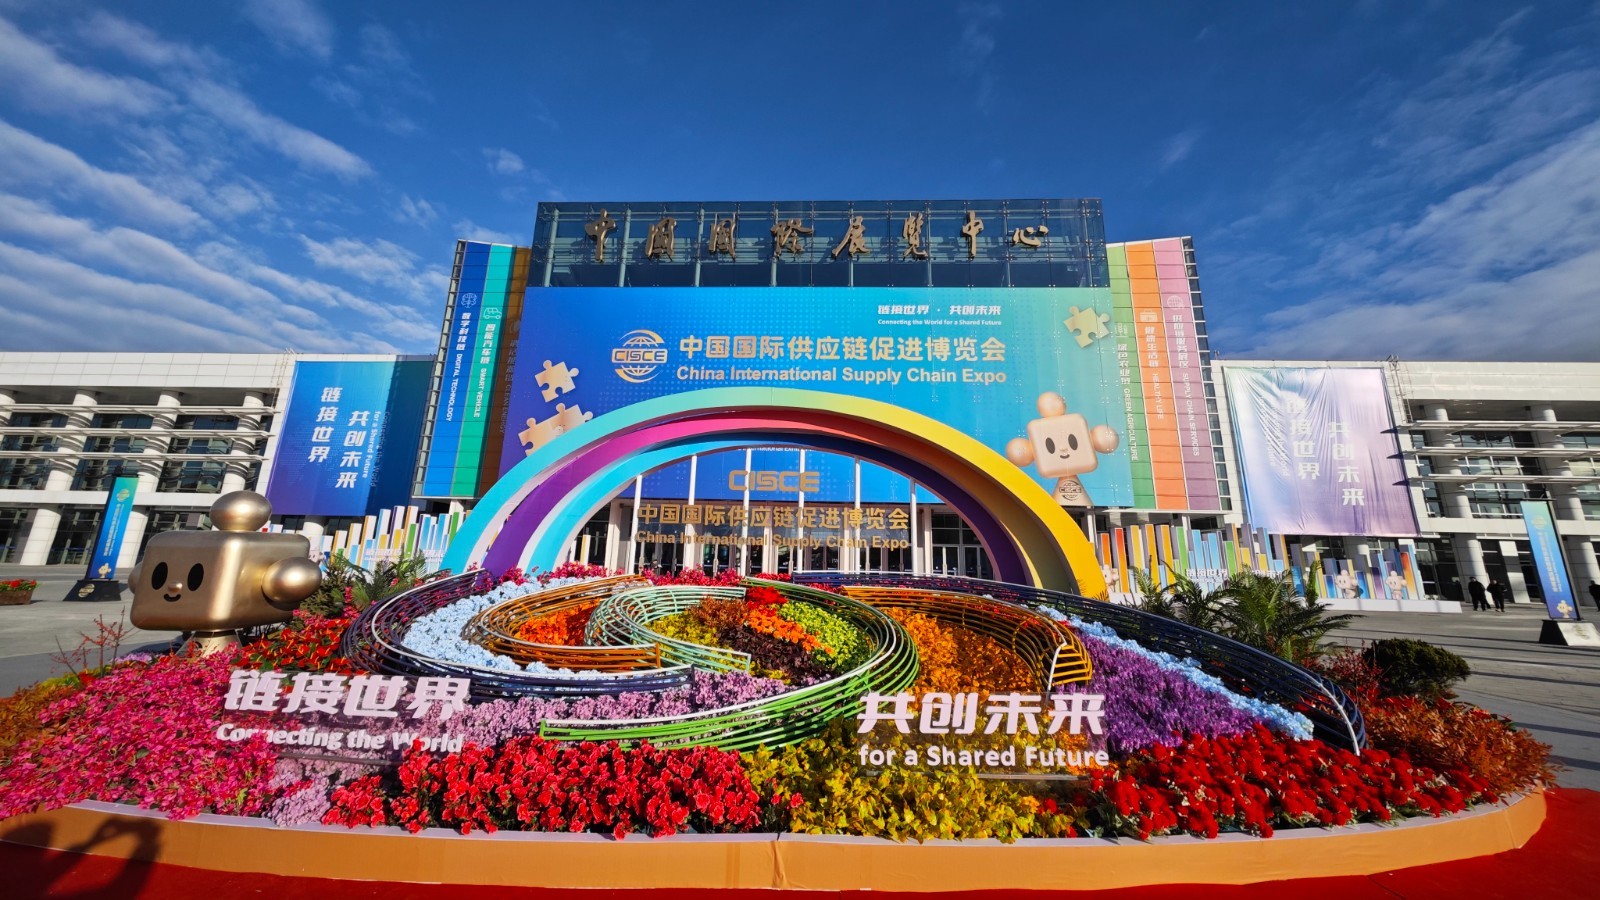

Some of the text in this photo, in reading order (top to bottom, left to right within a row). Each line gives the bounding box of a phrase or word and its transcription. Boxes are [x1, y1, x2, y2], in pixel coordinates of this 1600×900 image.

[877, 304, 1001, 316] 链接世界 共创未来
[614, 350, 665, 362] CISCE
[679, 334, 1005, 361] 中国国际供应链促进博览会
[446, 353, 463, 421] DIGITAL TECHNOLOGY
[676, 365, 1007, 386] China International Supply Chain Expo
[473, 368, 487, 418] SMART VEHICLE
[1152, 373, 1164, 419] HEALTHY LIFE
[373, 411, 381, 421] for
[500, 384, 512, 433] CLEAN ENERGY
[1183, 373, 1199, 456] SUPPLY CHAIN SERVICES
[308, 387, 343, 463] 链接世界
[1123, 388, 1138, 461] GREEN AGRICULTURE
[335, 410, 371, 489] 共创未来
[367, 429, 378, 453] Shared
[362, 455, 373, 478] Future
[1328, 420, 1366, 506] 共创未来
[728, 470, 820, 492] CISCE
[637, 504, 909, 530] 中国国际供应链促进博览会
[635, 530, 909, 551] China International Supply Chain Expo
[224, 669, 471, 719] 链接世界
[857, 692, 1105, 735] 共创未来
[347, 729, 385, 750] the
[858, 745, 1109, 766] for a Shared Future
